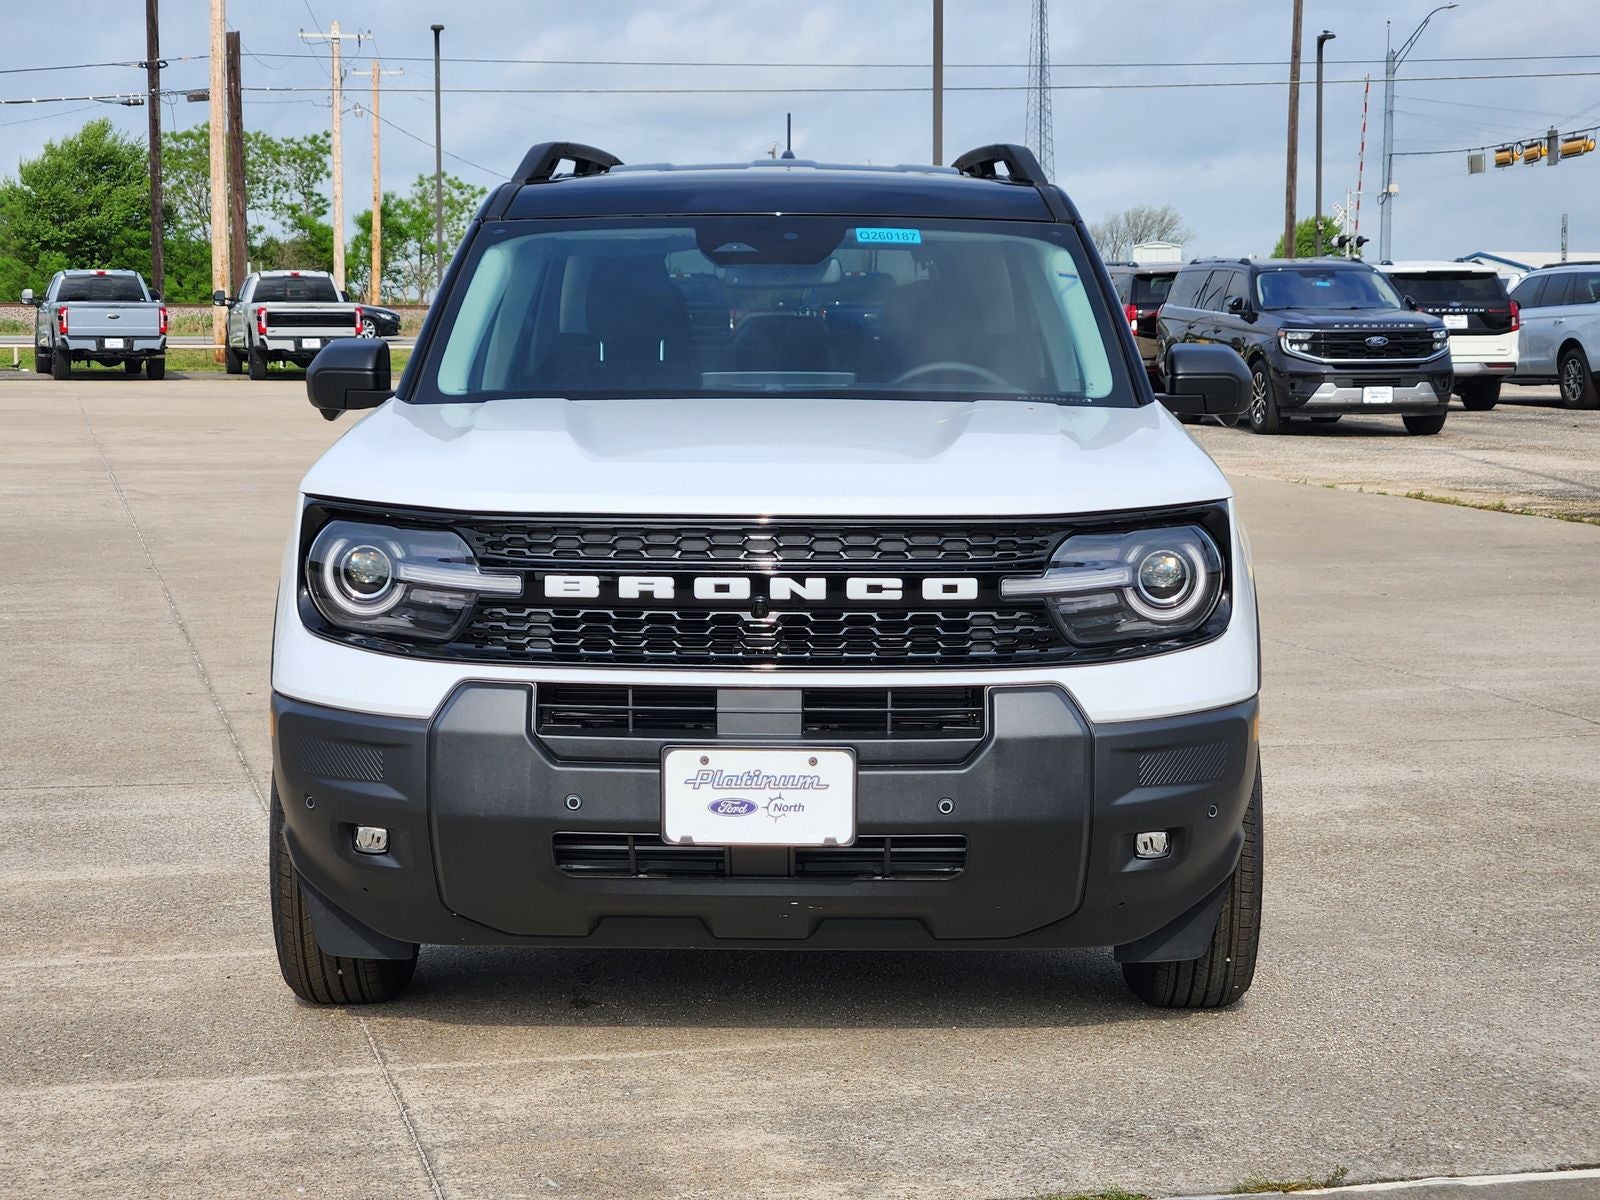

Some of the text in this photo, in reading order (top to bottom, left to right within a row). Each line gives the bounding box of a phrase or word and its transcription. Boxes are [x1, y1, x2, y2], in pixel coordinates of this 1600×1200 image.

[860, 230, 917, 241] Q260187
[543, 575, 979, 600] BRONCO
[684, 769, 830, 790] Platinum
[717, 800, 805, 815] Ford North
